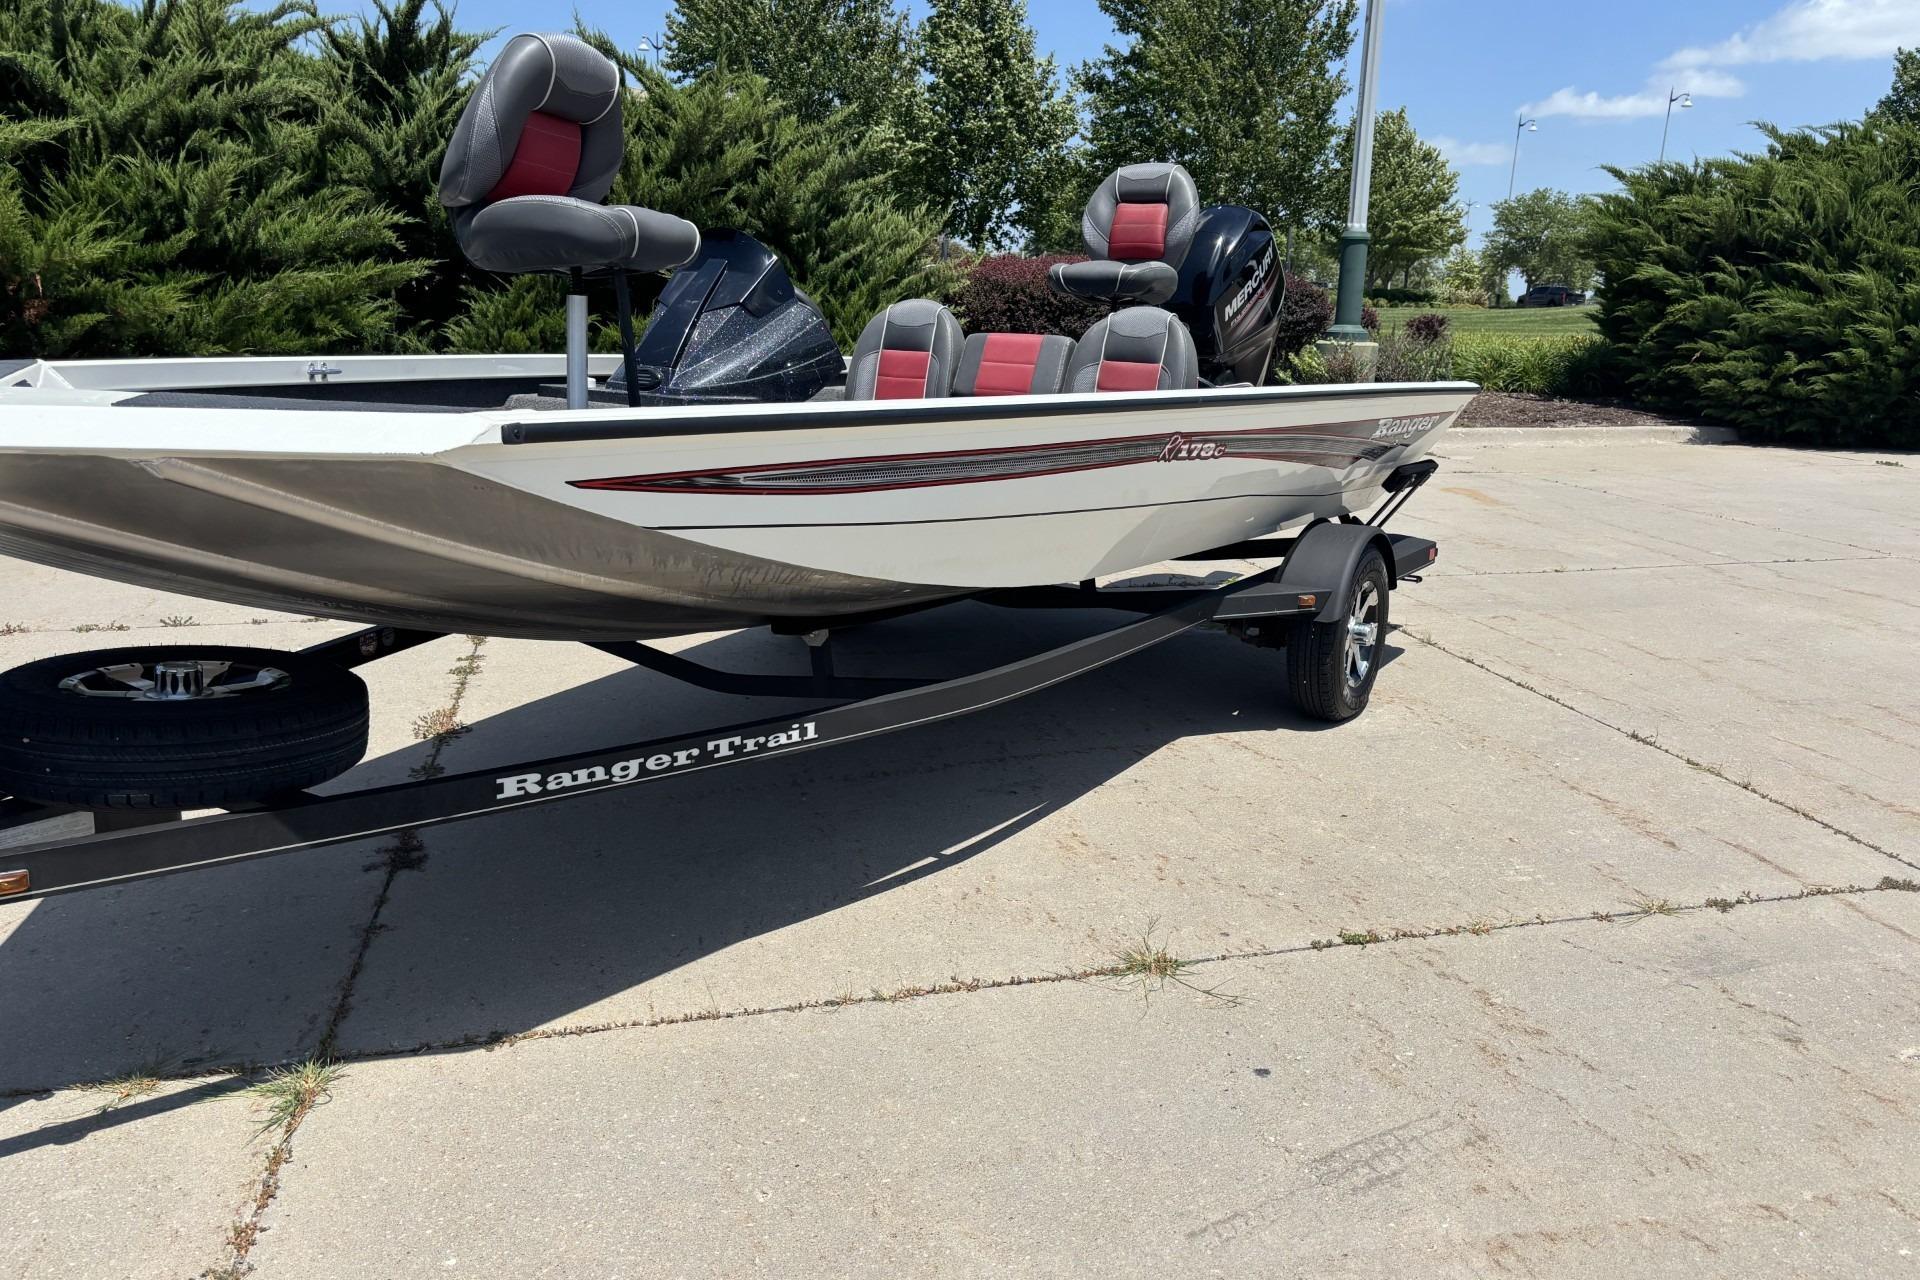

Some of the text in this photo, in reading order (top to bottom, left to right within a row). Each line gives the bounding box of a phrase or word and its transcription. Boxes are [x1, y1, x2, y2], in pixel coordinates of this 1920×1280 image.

[1224, 240, 1274, 322] MERCURY
[1370, 415, 1440, 439] Ranger
[495, 721, 819, 801] Ranger Trail
